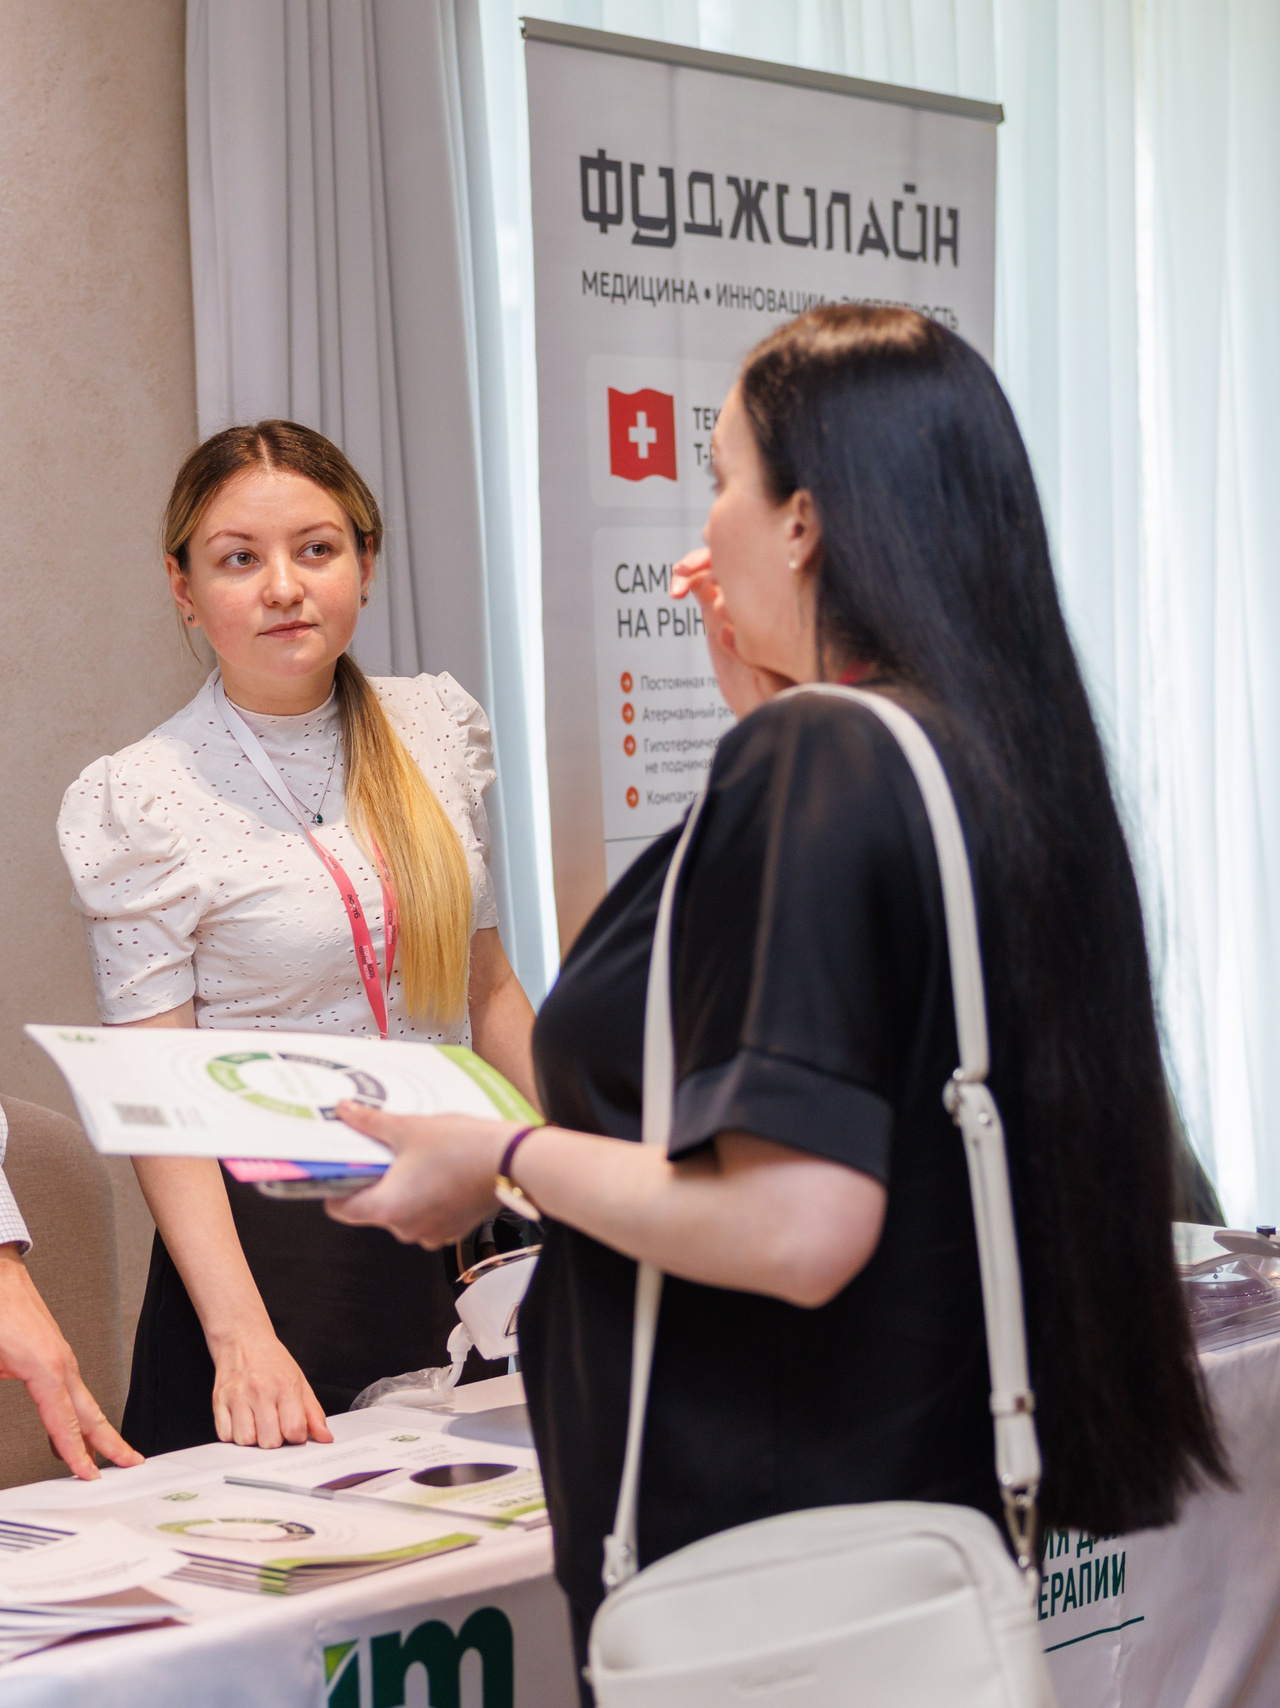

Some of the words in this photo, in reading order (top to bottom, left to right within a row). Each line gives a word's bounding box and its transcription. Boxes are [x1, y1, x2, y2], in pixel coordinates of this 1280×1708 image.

[580, 148, 959, 267] ФУДЖИЛАЙН
[582, 270, 699, 307] МЕДИЦИНА
[615, 563, 673, 594] САМ
[617, 608, 650, 638] НА
[641, 674, 704, 691] Постоянная
[642, 702, 716, 724] Атермальный
[645, 761, 658, 774] не
